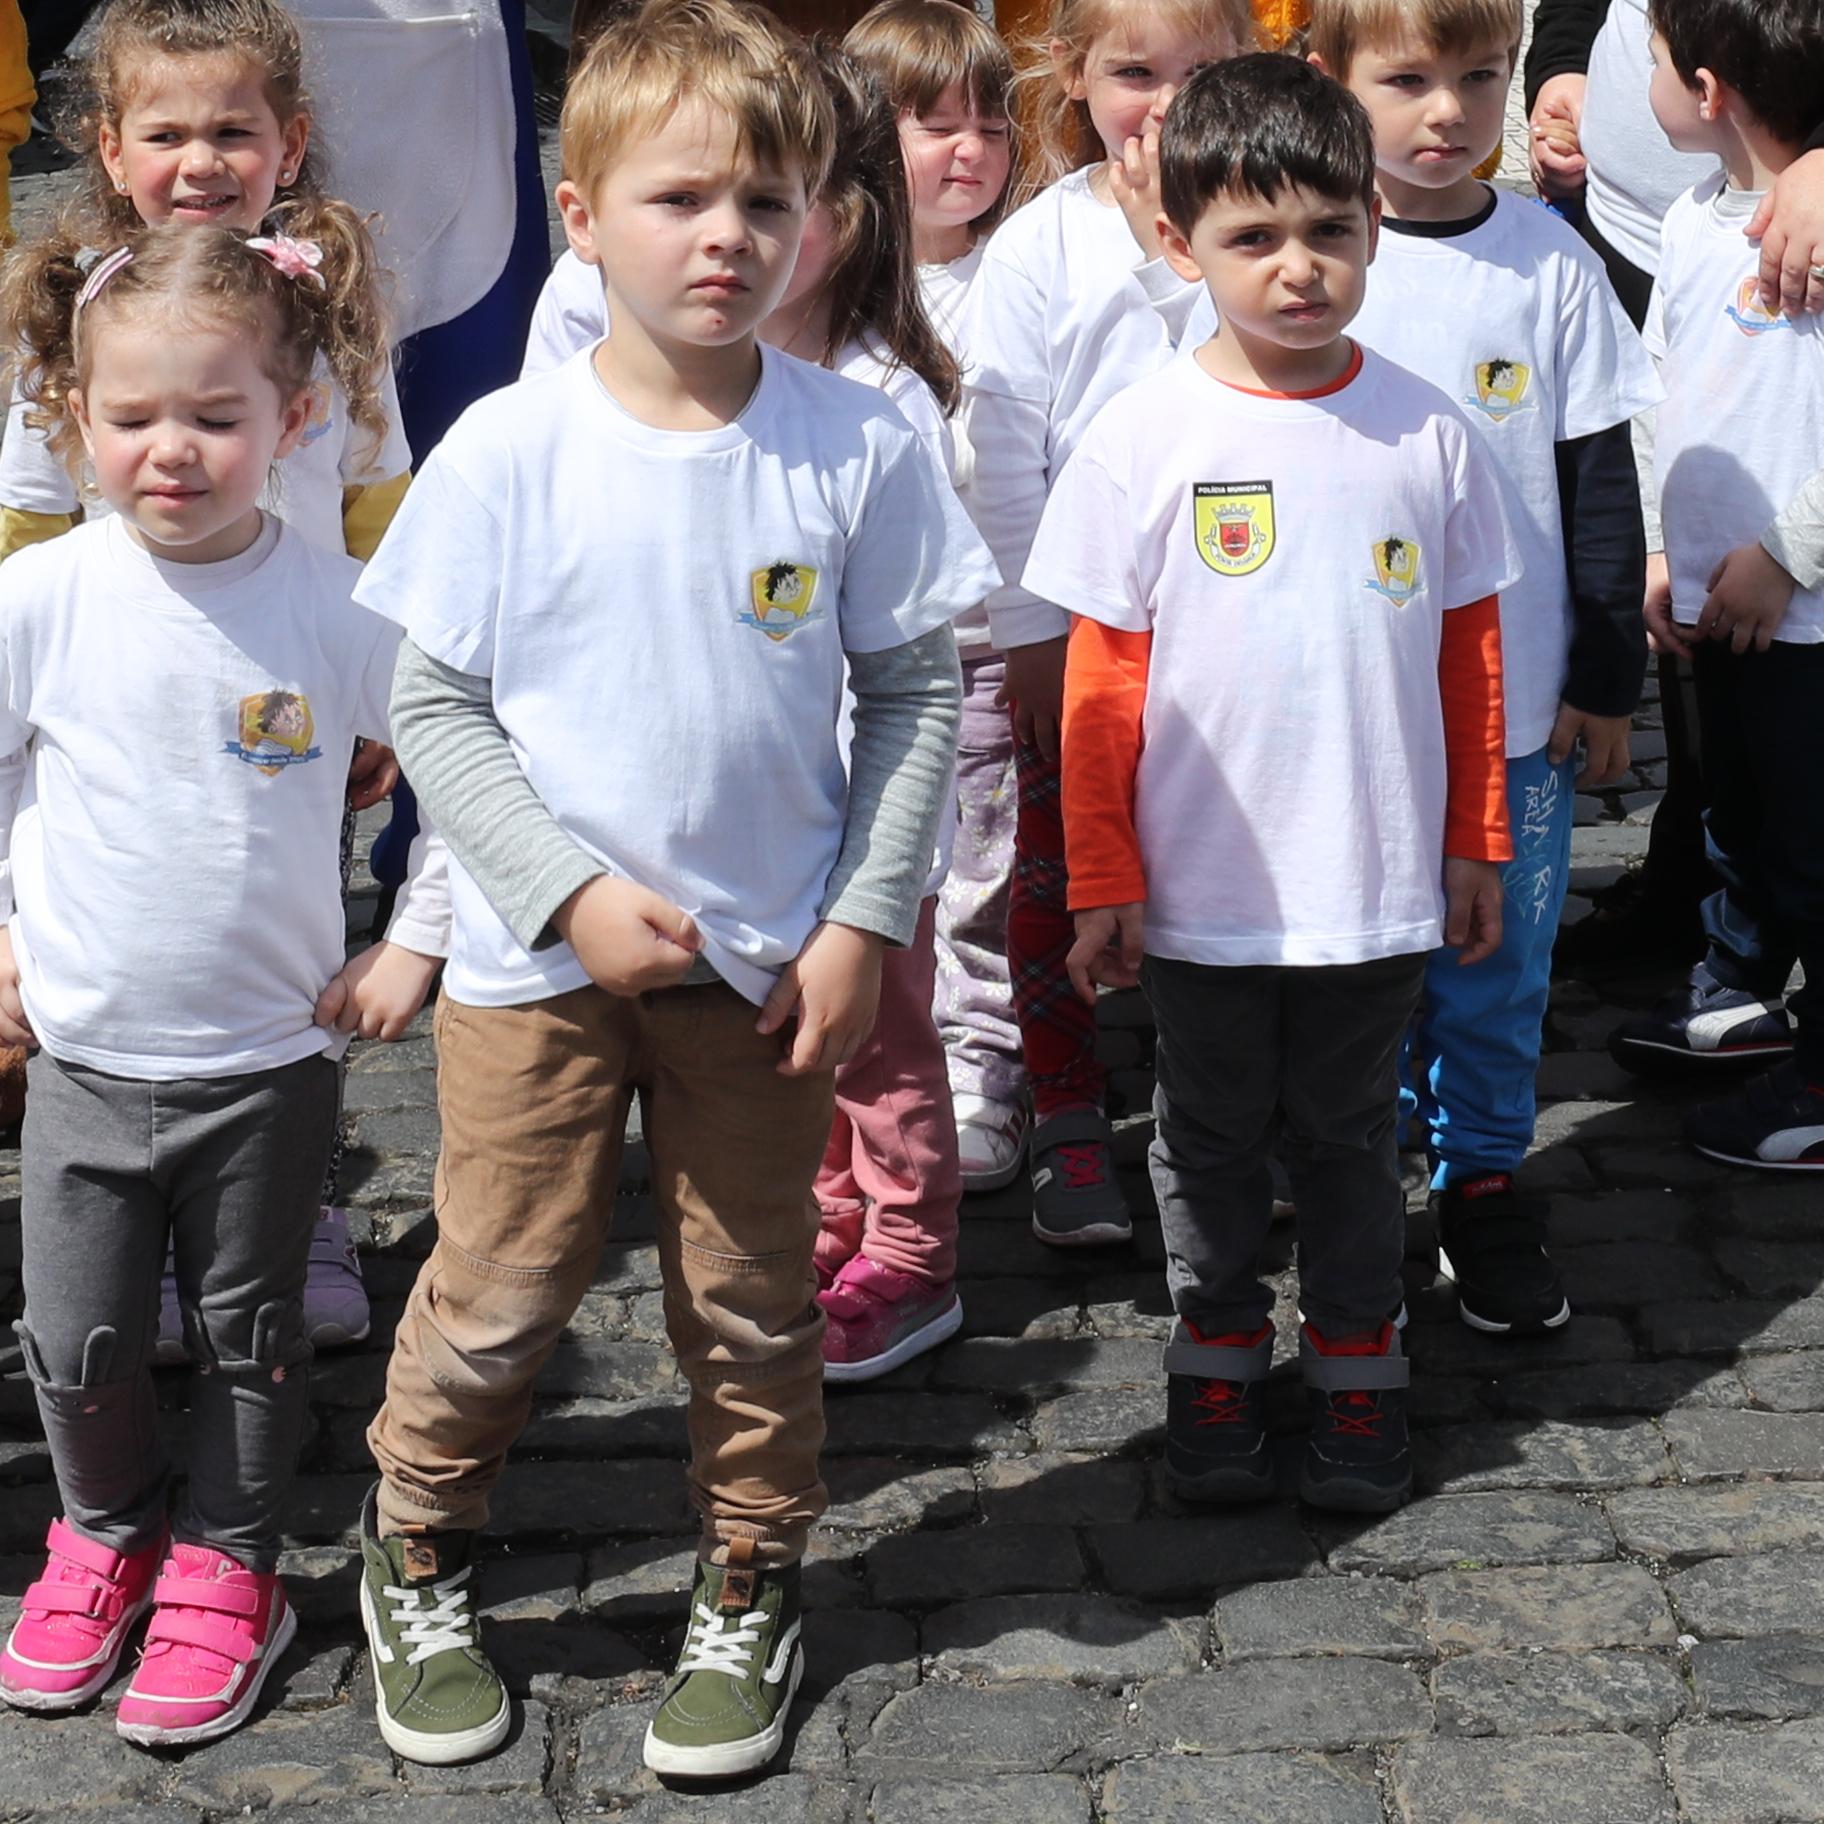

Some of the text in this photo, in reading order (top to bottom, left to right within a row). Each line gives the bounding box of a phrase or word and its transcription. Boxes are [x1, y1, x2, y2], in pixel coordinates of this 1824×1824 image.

[1198, 484, 1268, 494] POLÍCIA MUNICIPAL
[1521, 785, 1540, 837] AREA
